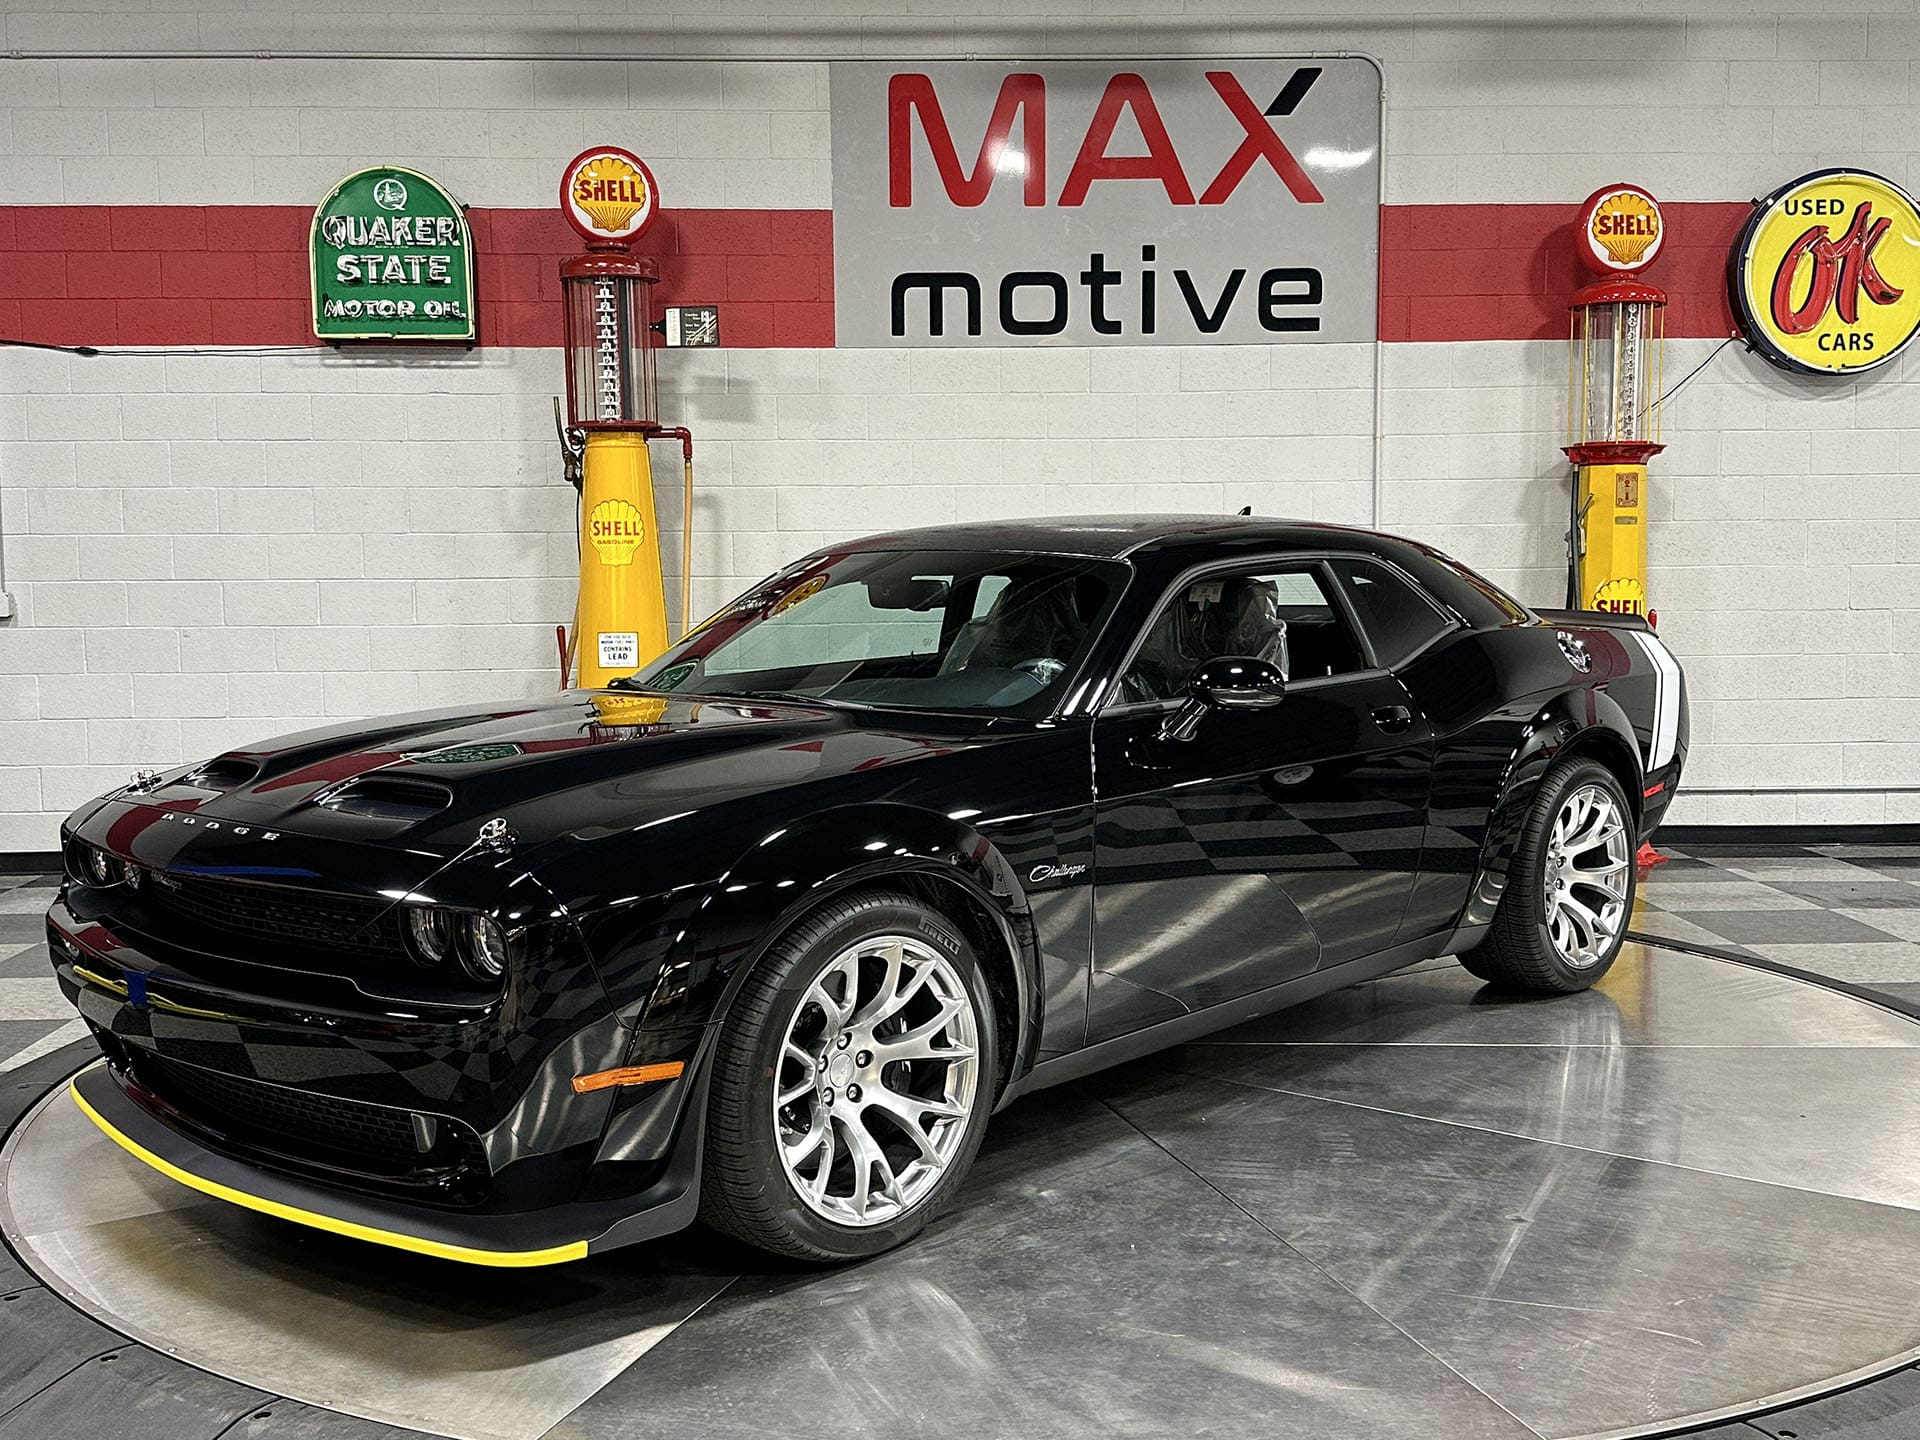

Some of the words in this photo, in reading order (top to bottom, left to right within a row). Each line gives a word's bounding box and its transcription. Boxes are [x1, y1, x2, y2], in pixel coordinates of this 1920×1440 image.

[888, 67, 1325, 207] MAX
[579, 179, 641, 203] SHELL
[1784, 199, 1845, 216] USED
[322, 215, 461, 249] QUAKER
[1598, 214, 1655, 236] SHELL
[336, 254, 452, 285] STATE
[1770, 201, 1905, 335] OK
[890, 244, 1324, 337] motive
[324, 299, 416, 318] MOTOR
[423, 300, 467, 319] OIL
[1818, 333, 1875, 351] CARS
[593, 520, 640, 536] SHELL
[161, 813, 280, 840] DODGE
[1029, 863, 1086, 882] Challenger
